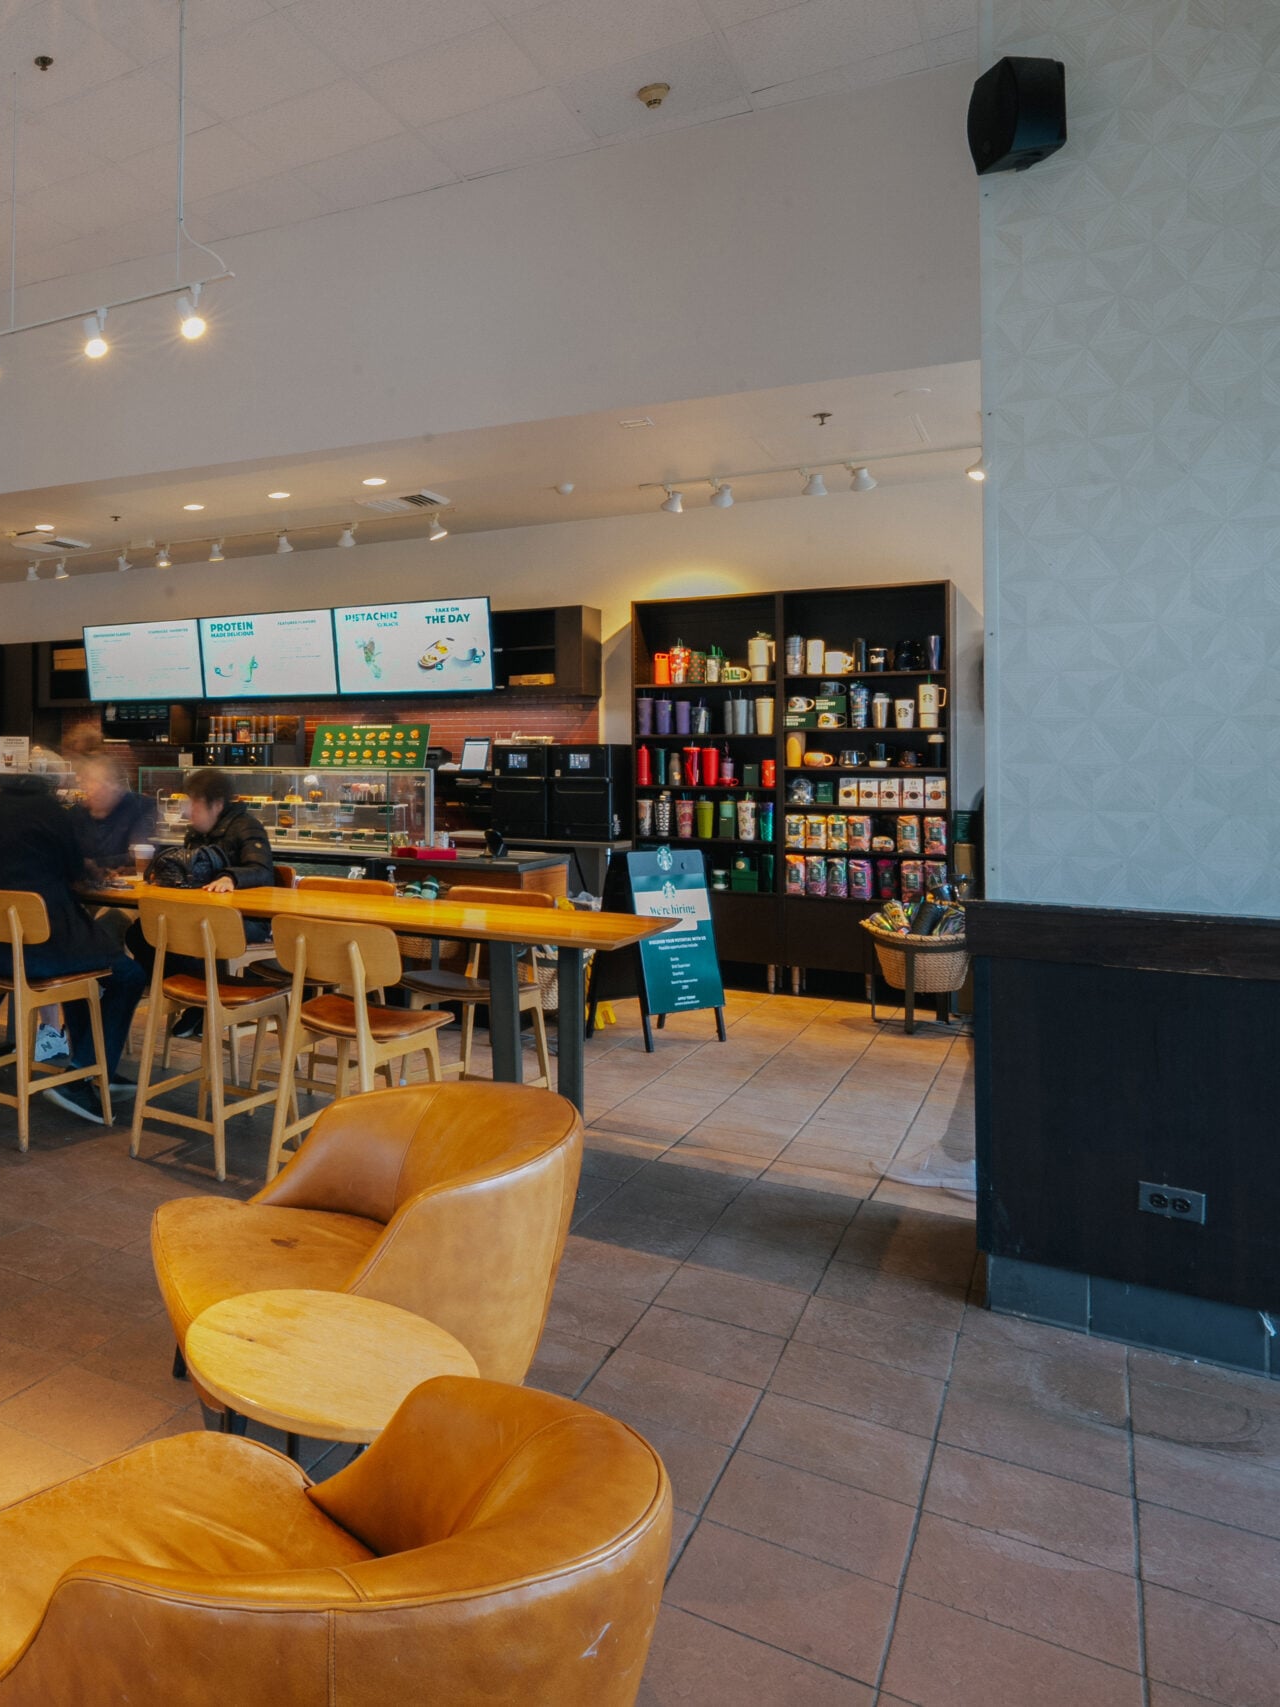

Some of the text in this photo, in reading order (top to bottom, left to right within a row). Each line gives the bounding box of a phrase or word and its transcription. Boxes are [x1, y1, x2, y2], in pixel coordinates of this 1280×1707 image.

[425, 613, 471, 625] THE DAY
[210, 620, 253, 633] PROTEIN
[671, 903, 696, 914] hiring
